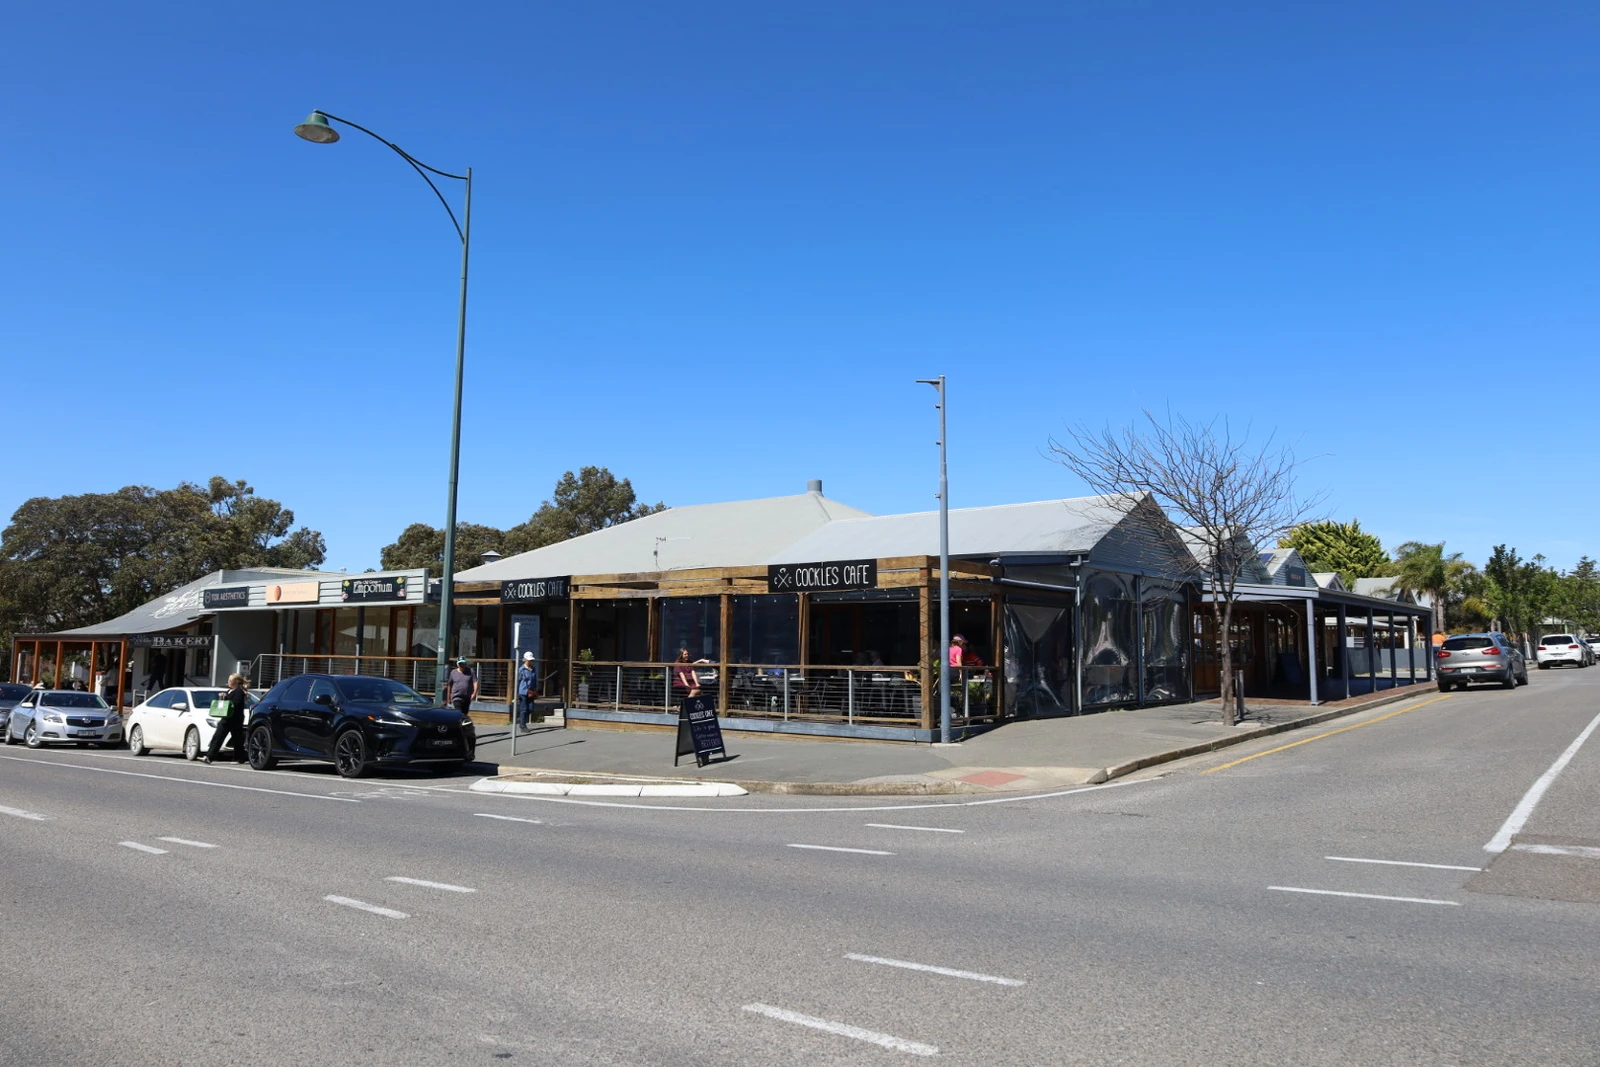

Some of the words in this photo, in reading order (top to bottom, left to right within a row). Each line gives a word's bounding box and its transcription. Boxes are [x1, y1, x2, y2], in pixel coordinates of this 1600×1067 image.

[795, 566, 839, 587] COCKLES
[843, 564, 870, 585] CAFE
[220, 591, 246, 601] AESTHETICS
[517, 581, 546, 599] COCKLES
[547, 580, 565, 597] CAFE
[151, 636, 212, 647] BAKERY
